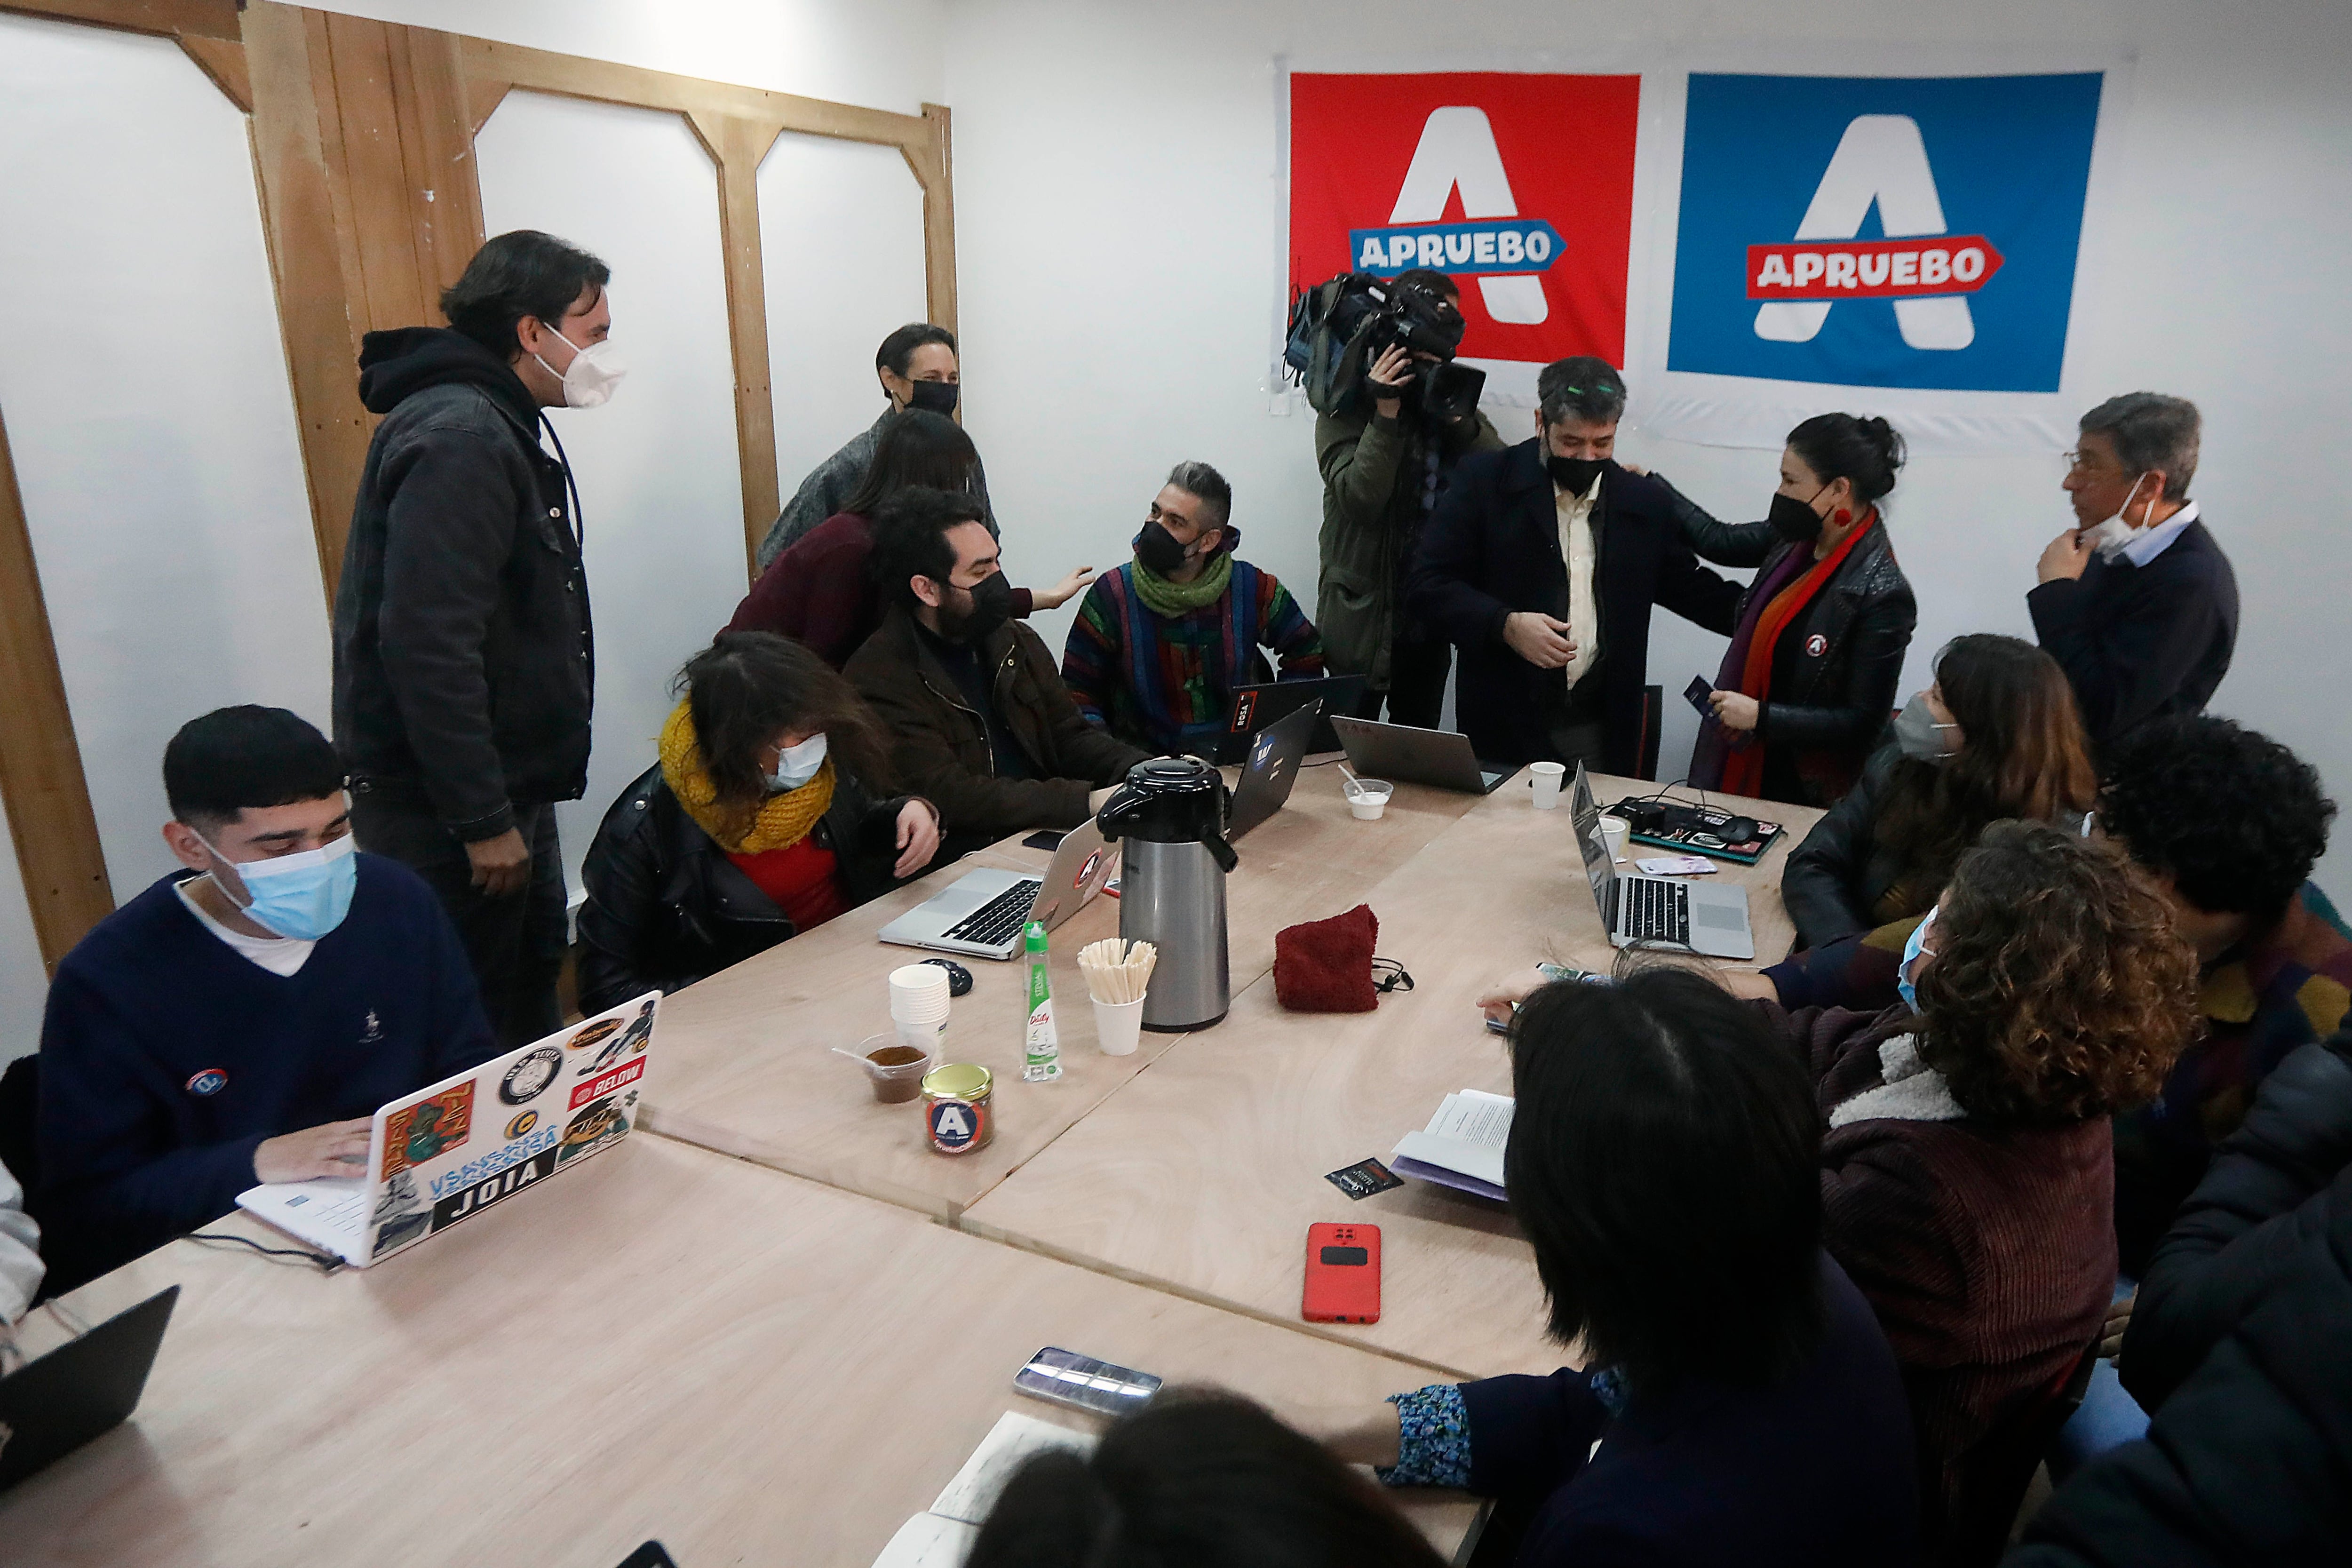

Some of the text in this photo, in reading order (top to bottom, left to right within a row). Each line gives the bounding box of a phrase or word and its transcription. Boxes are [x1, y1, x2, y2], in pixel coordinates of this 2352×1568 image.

[1359, 230, 1551, 269] APRUEBO
[1753, 113, 1975, 350] A
[1756, 247, 1985, 291] APRUEBO
[1237, 704, 1249, 726] ROSA
[1030, 1013, 1049, 1025] Daily
[593, 1063, 642, 1097] BELOW
[936, 1106, 970, 1136] A
[450, 1159, 538, 1218] JOIA
